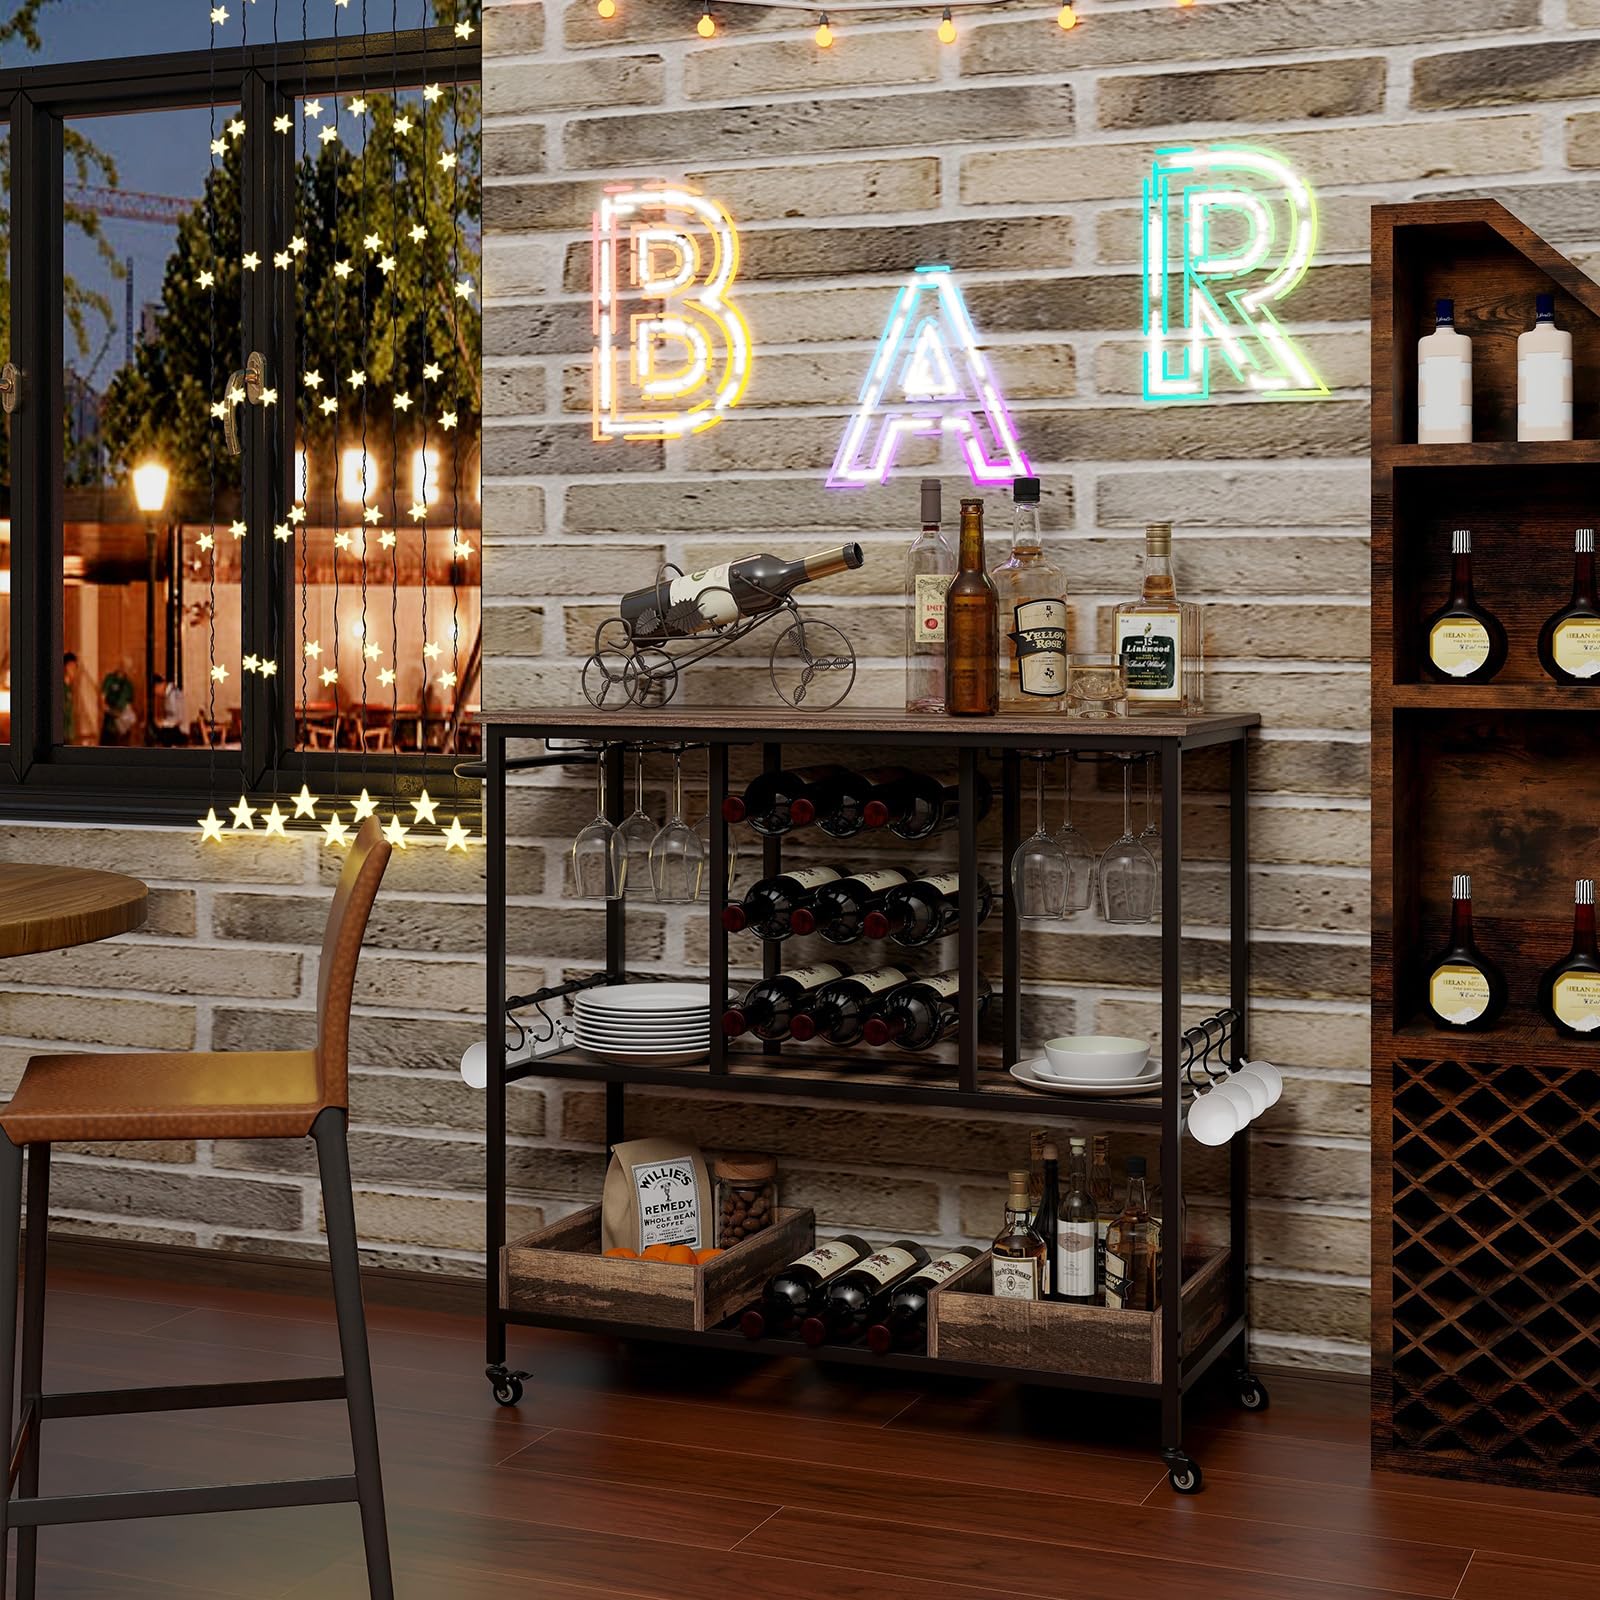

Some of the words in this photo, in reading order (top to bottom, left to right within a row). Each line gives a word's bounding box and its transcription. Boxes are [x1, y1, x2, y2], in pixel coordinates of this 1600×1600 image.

[593, 142, 1331, 487] BAR
[1020, 631, 1066, 642] YELLOW
[1035, 639, 1062, 649] ROSE
[1126, 644, 1170, 653] Linkwood
[640, 1168, 692, 1189] WILLIE'S
[645, 1199, 693, 1215] REMEDY
[644, 1216, 672, 1226] WHOLE
[674, 1210, 696, 1221] BEAN
[656, 1220, 685, 1229] COFFEE
